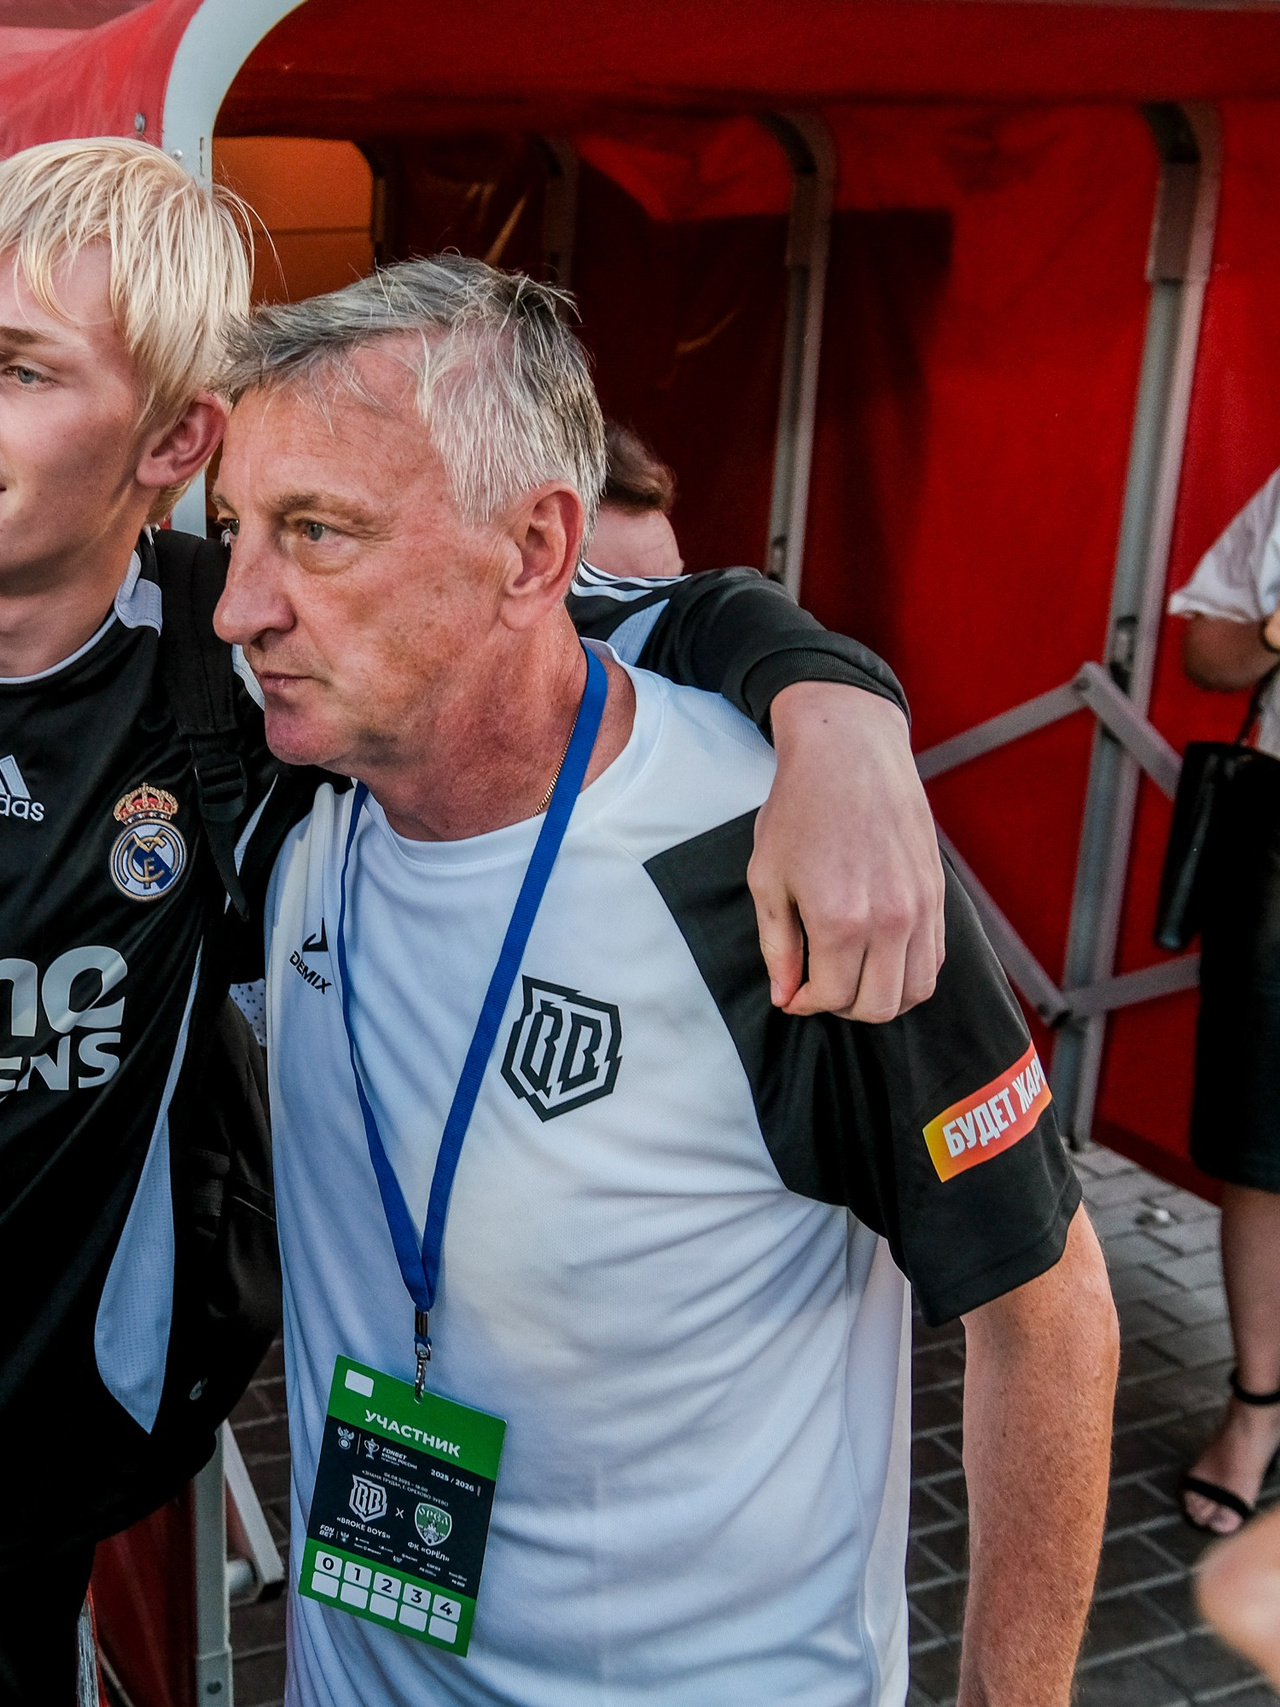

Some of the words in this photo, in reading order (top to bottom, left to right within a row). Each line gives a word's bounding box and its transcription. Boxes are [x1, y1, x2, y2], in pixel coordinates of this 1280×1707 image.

[289, 950, 332, 995] DEMIX
[942, 1087, 1017, 1158] БУДЕТ
[365, 1409, 461, 1458] УЧАСТНИК
[382, 1447, 407, 1460] FONBET
[430, 1469, 449, 1482] 2025
[455, 1479, 475, 1492] 2026
[319, 1530, 334, 1539] BET
[320, 1524, 335, 1533] FON
[336, 1516, 366, 1531] «BROKE
[367, 1526, 391, 1539] BOYS»
[408, 1541, 420, 1551] ФК
[322, 1557, 334, 1571] 0
[354, 1567, 361, 1581] 1
[381, 1578, 393, 1593] 2
[410, 1588, 422, 1603] 3
[439, 1602, 453, 1616] 4
